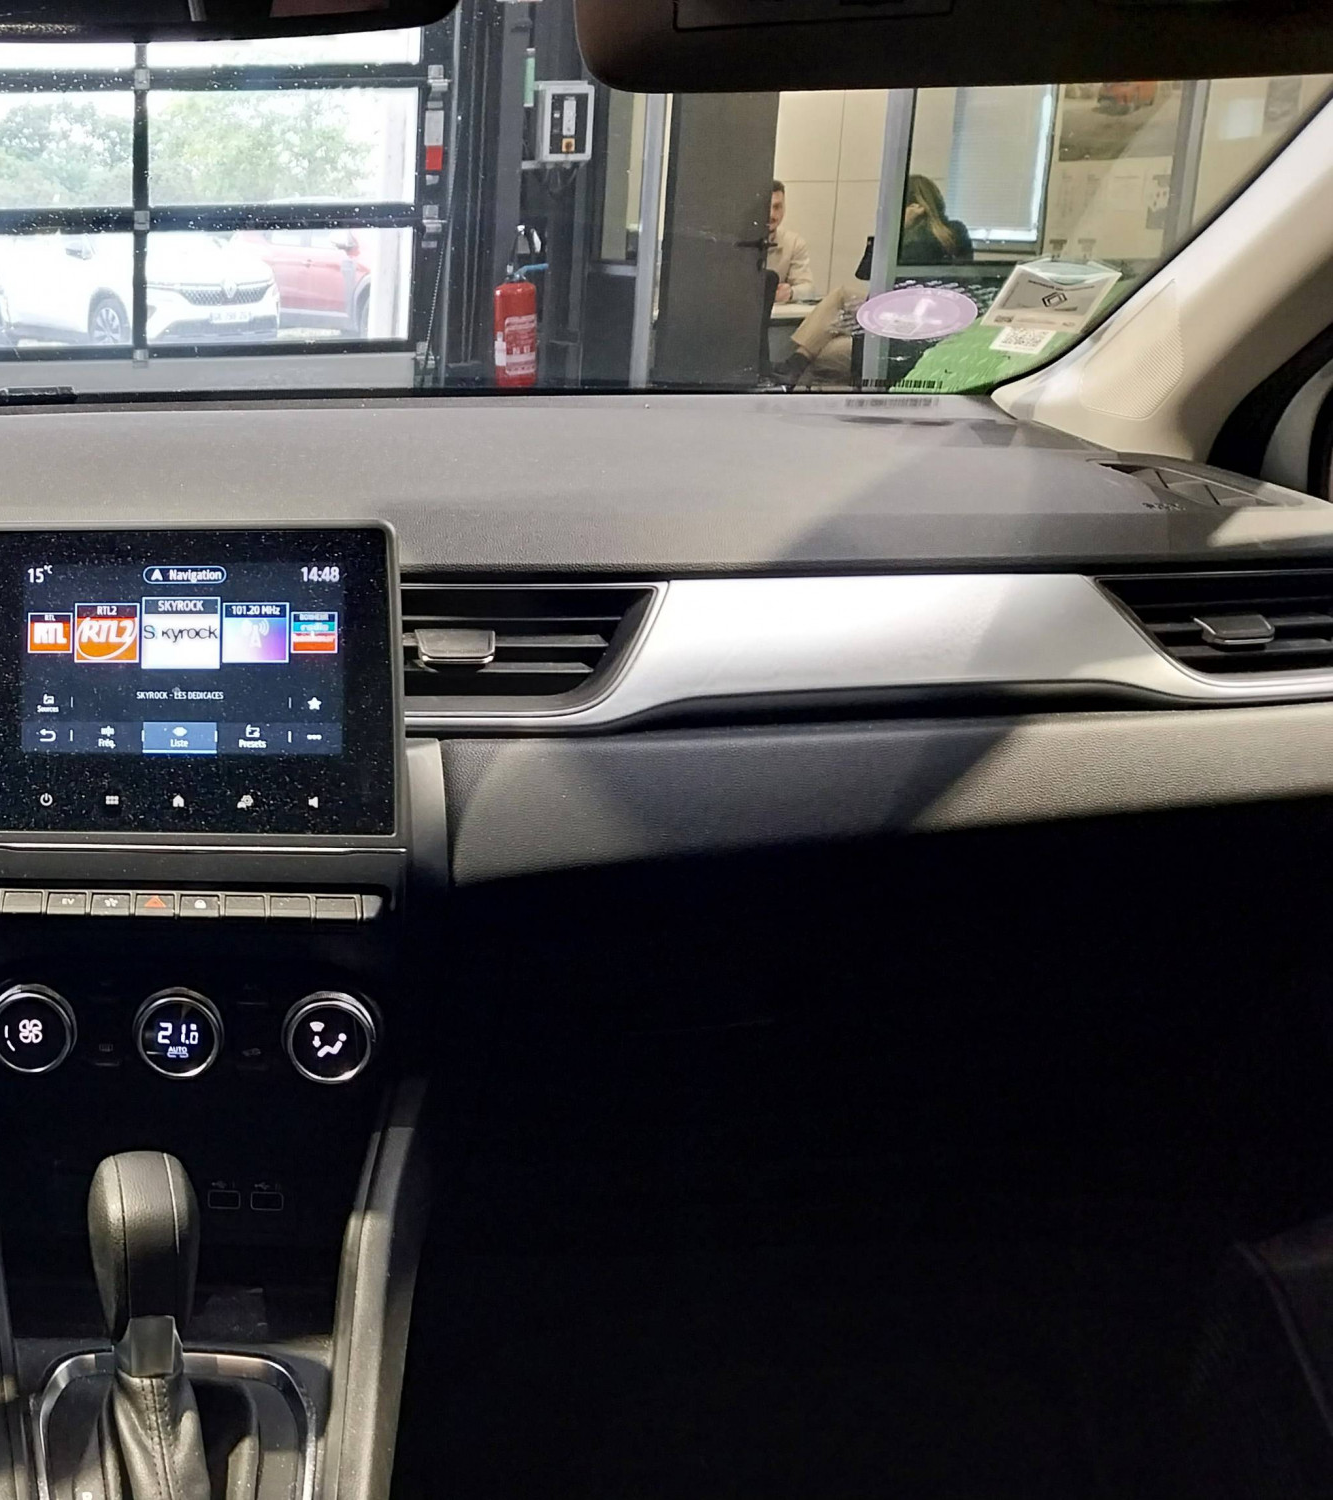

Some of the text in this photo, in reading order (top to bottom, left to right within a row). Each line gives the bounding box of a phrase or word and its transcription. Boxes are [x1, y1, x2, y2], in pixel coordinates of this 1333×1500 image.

[169, 569, 222, 583] Navigation
[300, 566, 340, 582] 14:48
[157, 600, 204, 611] SKYROCK
[96, 606, 118, 615] RTL2
[231, 606, 281, 615] 101.20 MHz
[33, 622, 67, 644] RTL
[80, 619, 134, 643] RTL2
[136, 691, 168, 699] SKYROCK
[174, 691, 187, 699] LES
[187, 691, 224, 699] DEDICACES
[36, 705, 59, 713] Sources
[170, 739, 189, 748] Liste
[238, 739, 267, 748] Presets
